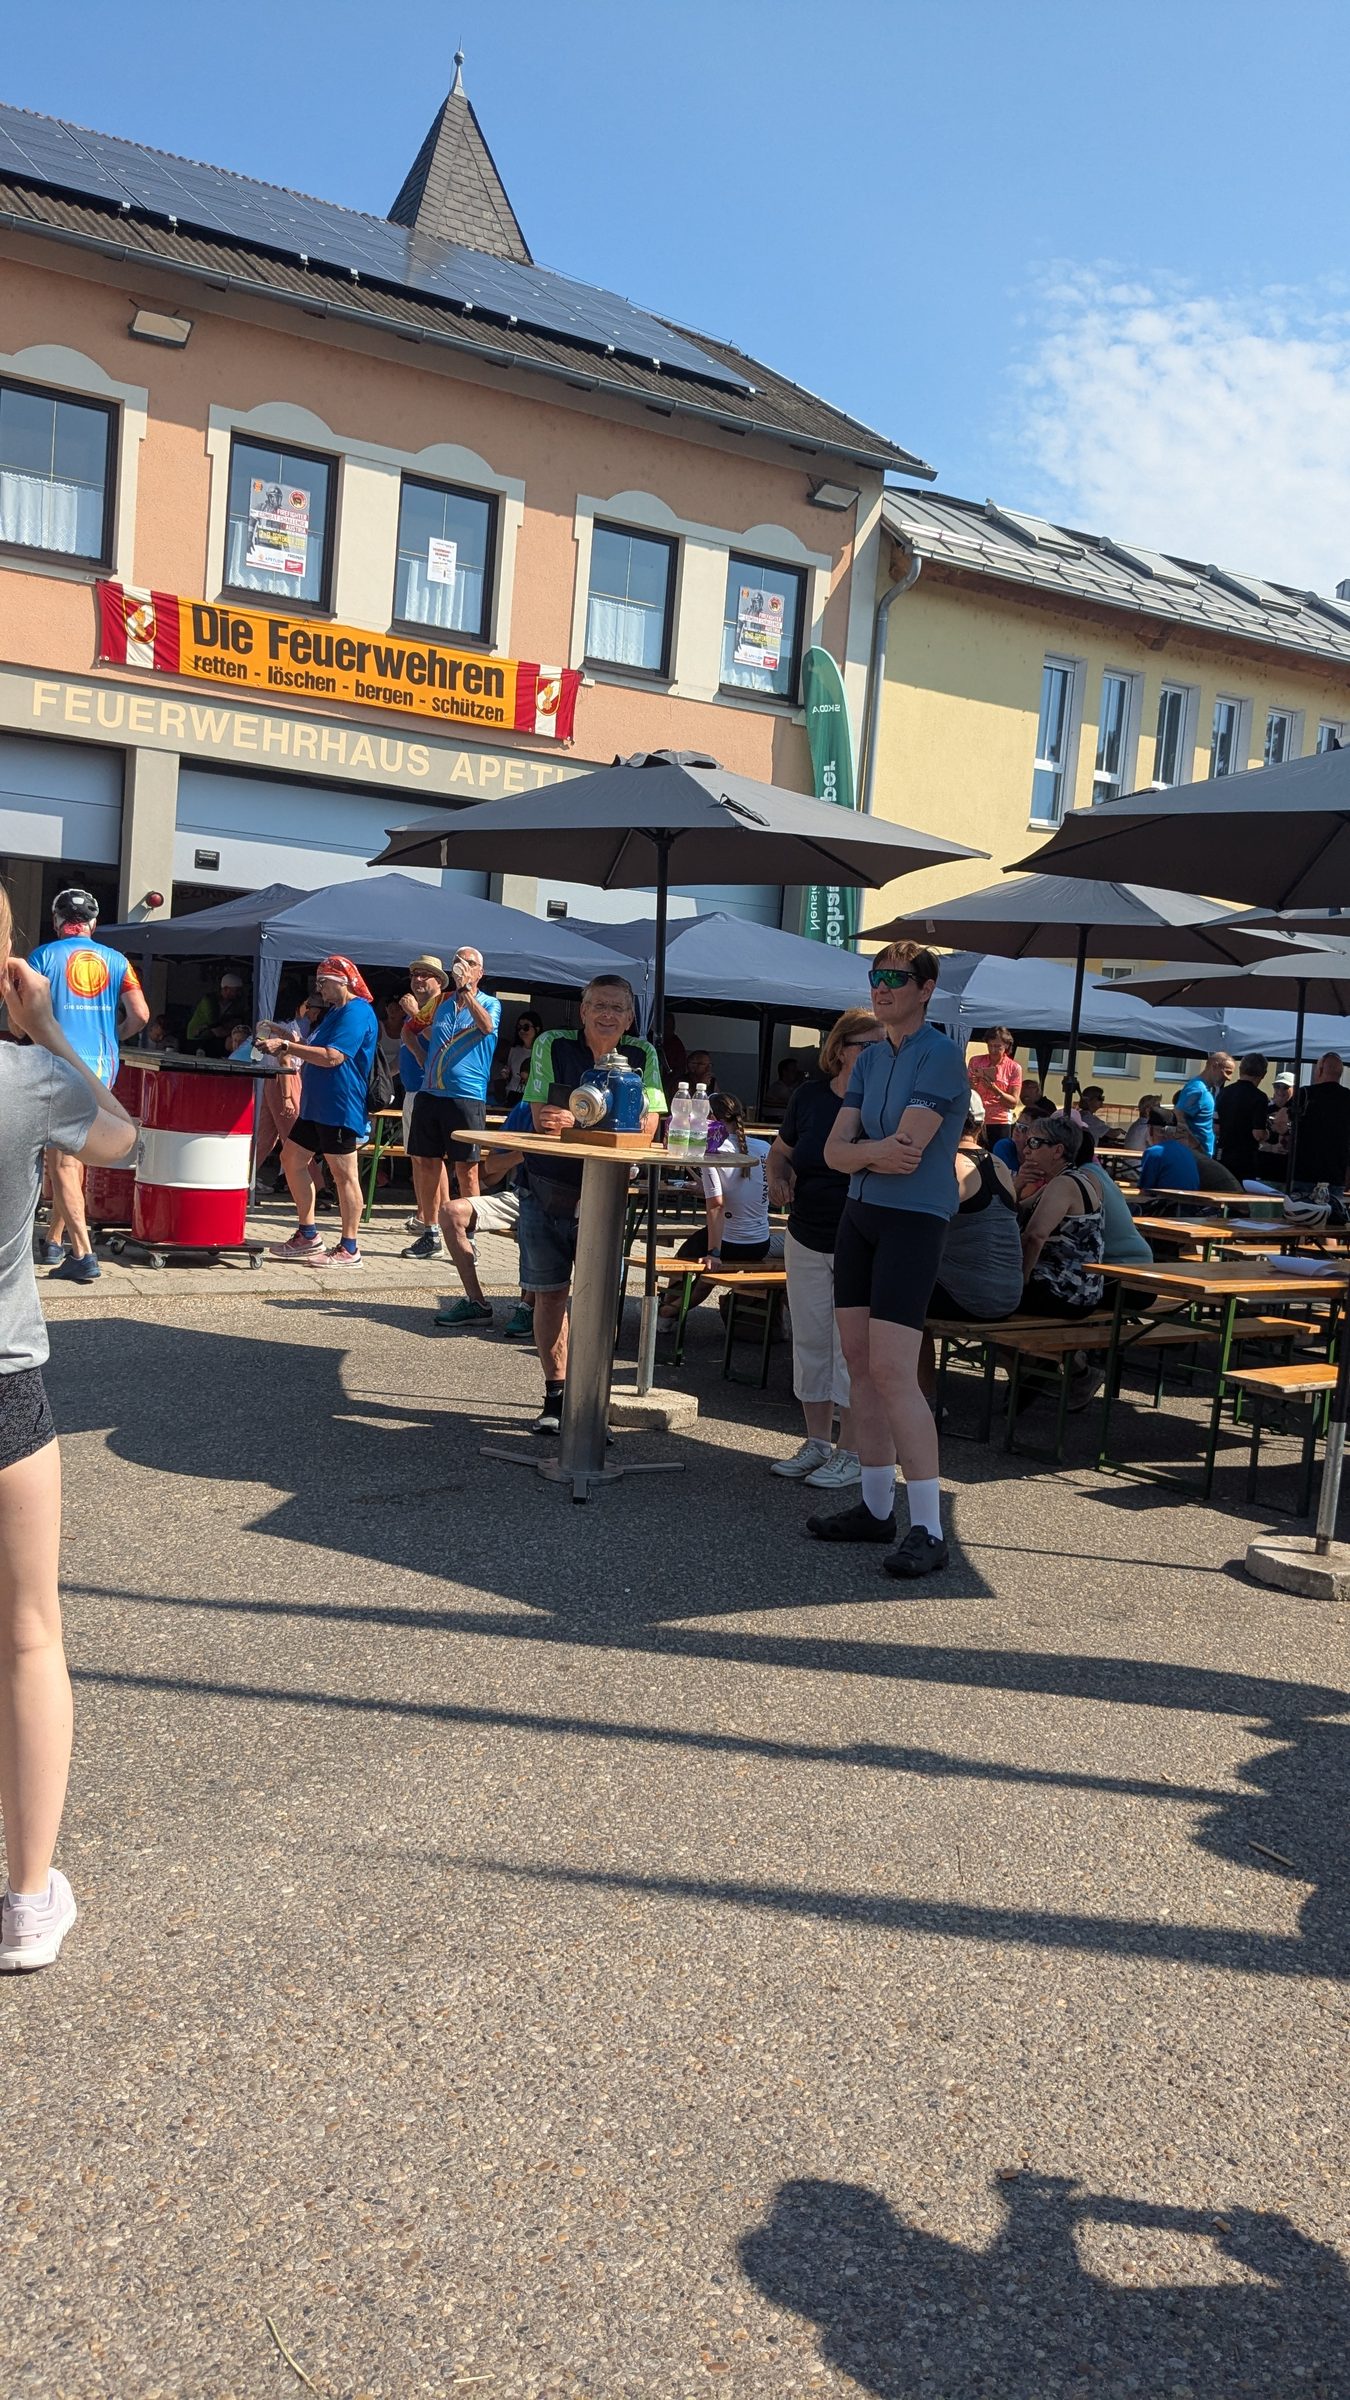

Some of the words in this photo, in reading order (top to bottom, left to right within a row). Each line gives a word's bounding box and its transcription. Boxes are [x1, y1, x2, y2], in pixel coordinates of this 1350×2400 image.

[192, 603, 254, 655] Die
[269, 619, 504, 698] Feuerwehren
[194, 654, 248, 680] retten
[268, 665, 336, 692] löschen
[355, 679, 414, 706] bergen
[432, 696, 504, 722] schützen
[33, 681, 430, 776] FEUERWEHRHAUS
